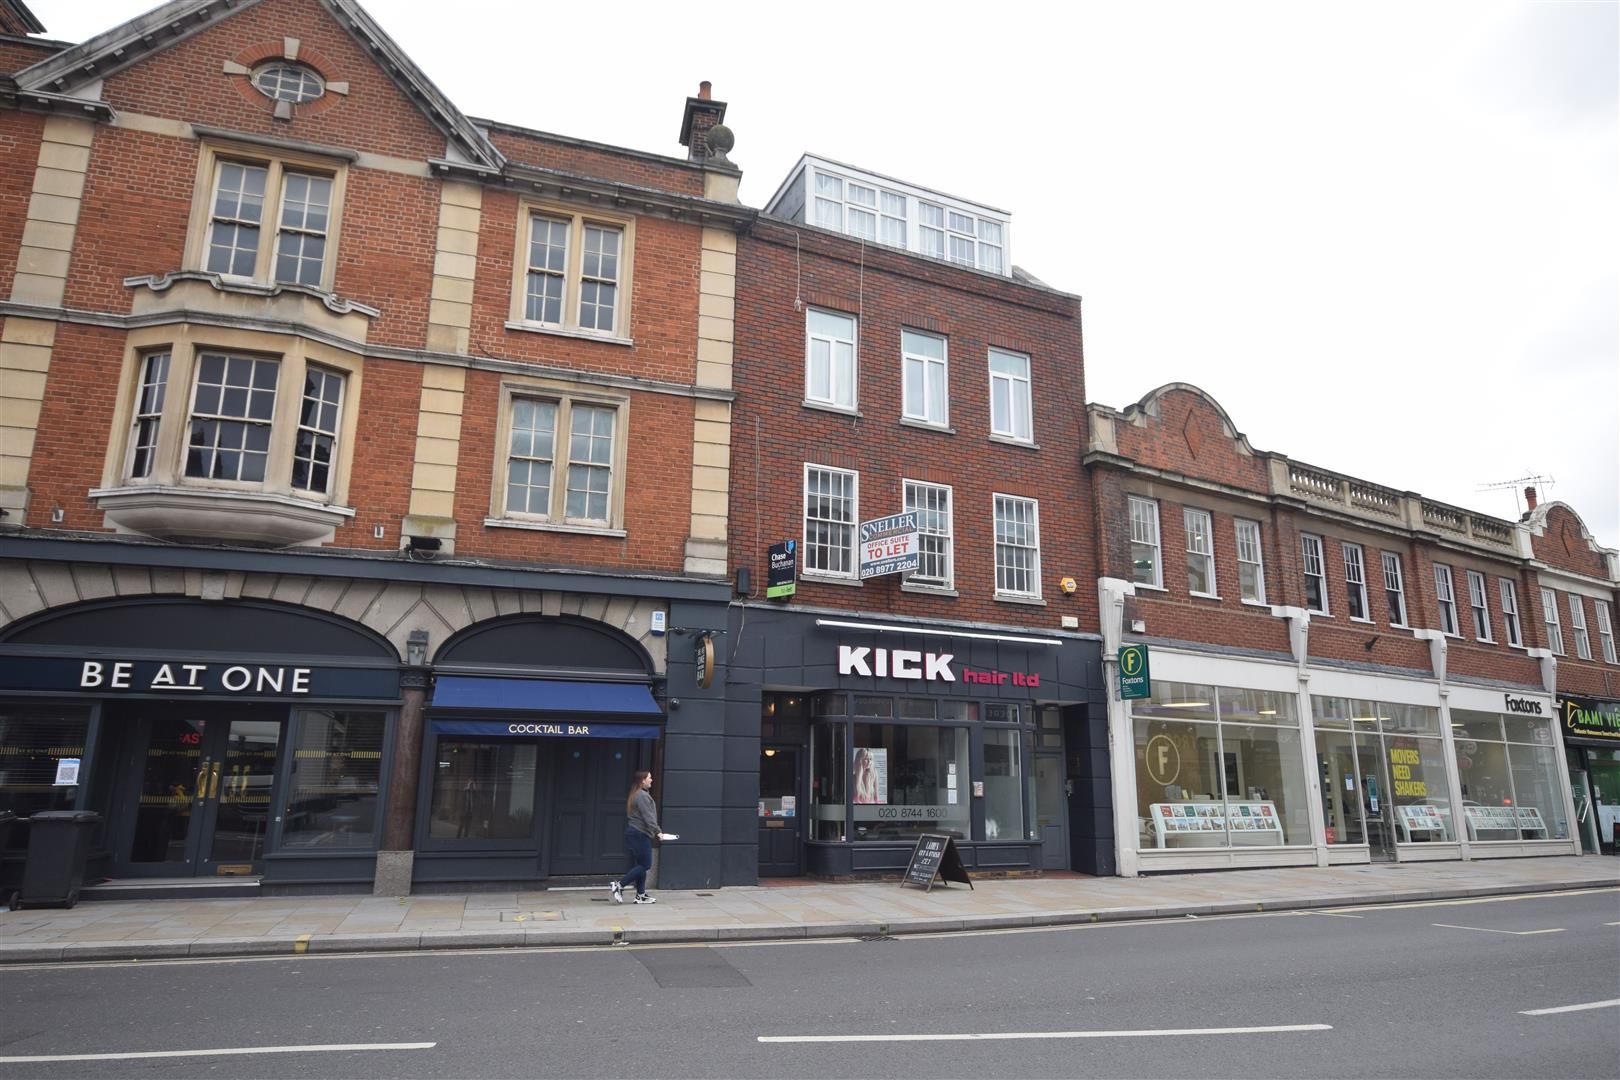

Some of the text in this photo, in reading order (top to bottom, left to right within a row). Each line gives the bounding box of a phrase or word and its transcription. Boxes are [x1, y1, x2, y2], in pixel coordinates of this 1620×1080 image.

[861, 514, 916, 542] SNELLER
[867, 535, 910, 549] OFFICE SUITE
[771, 553, 786, 562] Chase
[868, 542, 909, 560] TO LET
[771, 559, 794, 569] Buchanan
[861, 559, 917, 577] 020 8977 2204
[837, 644, 1041, 687] KICK hair ltd
[80, 661, 311, 694] BE AT ONE
[1122, 676, 1144, 685] Foxtons
[1504, 694, 1542, 715] Foxtons
[1577, 709, 1603, 726] BAMI
[508, 722, 590, 735] COCKTAIL BAR
[1390, 747, 1420, 765] MOVERS
[1392, 764, 1411, 780] NEED
[1394, 780, 1428, 797] SHAKERS
[878, 807, 948, 818] 020 8744 1600
